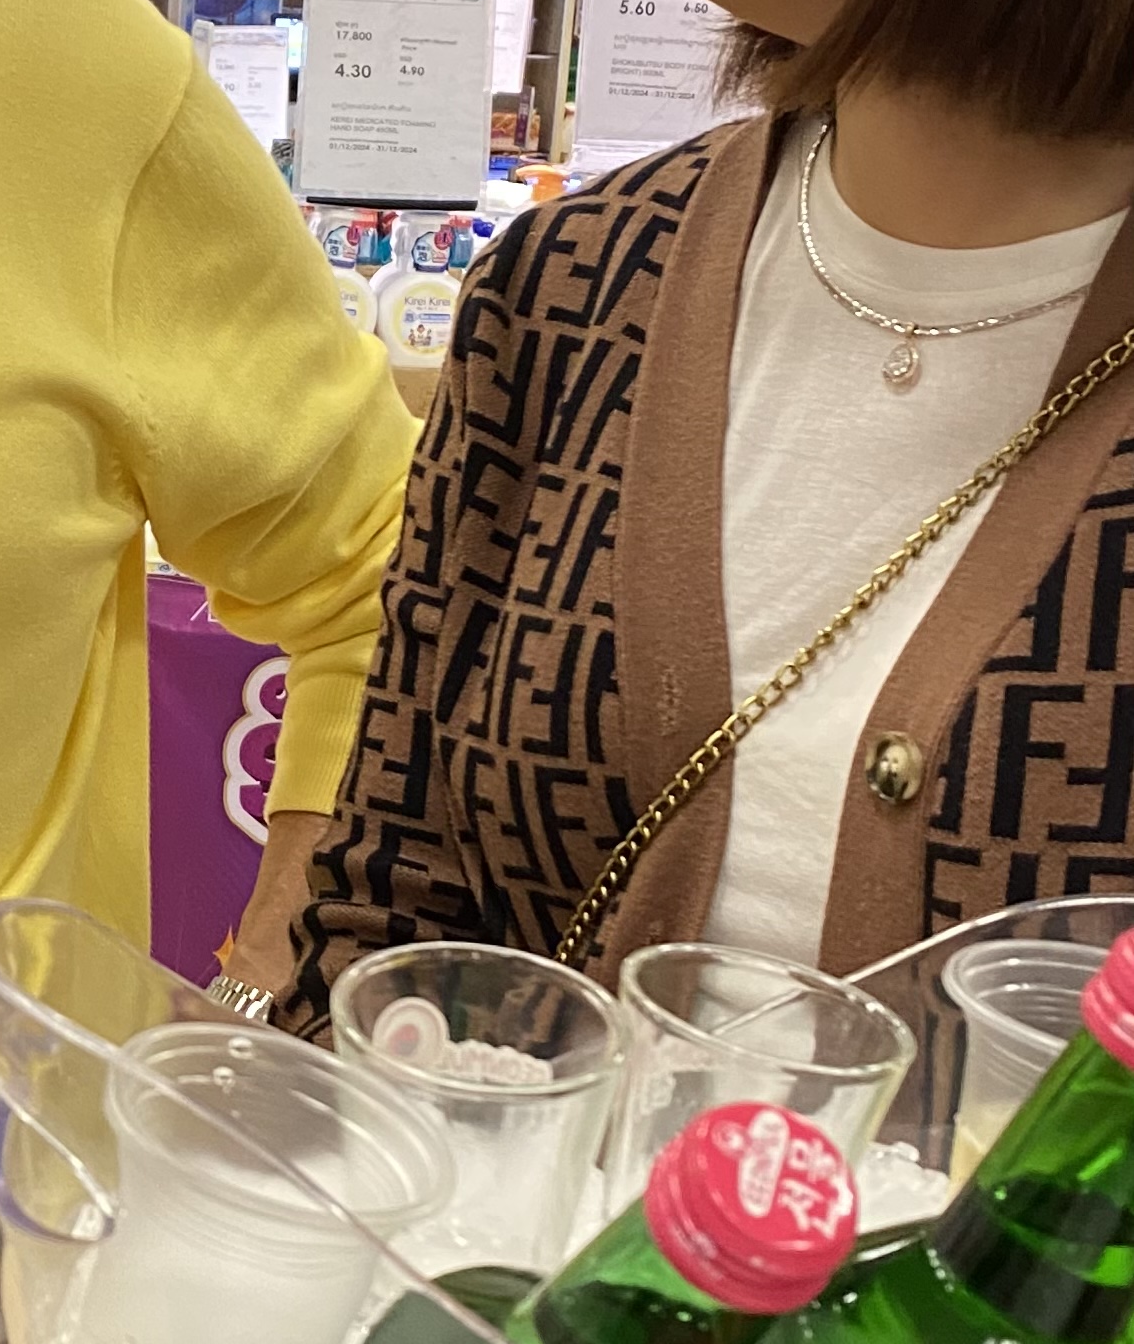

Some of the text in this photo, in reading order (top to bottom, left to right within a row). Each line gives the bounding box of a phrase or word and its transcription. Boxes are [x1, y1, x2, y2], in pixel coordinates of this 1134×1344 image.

[619, 0, 709, 16] 5.60 6.50
[336, 30, 373, 41] 17,800
[334, 63, 425, 78] 4.30 4.90
[353, 125, 374, 133] SOAP
[404, 296, 451, 306] Kirei Kirei
